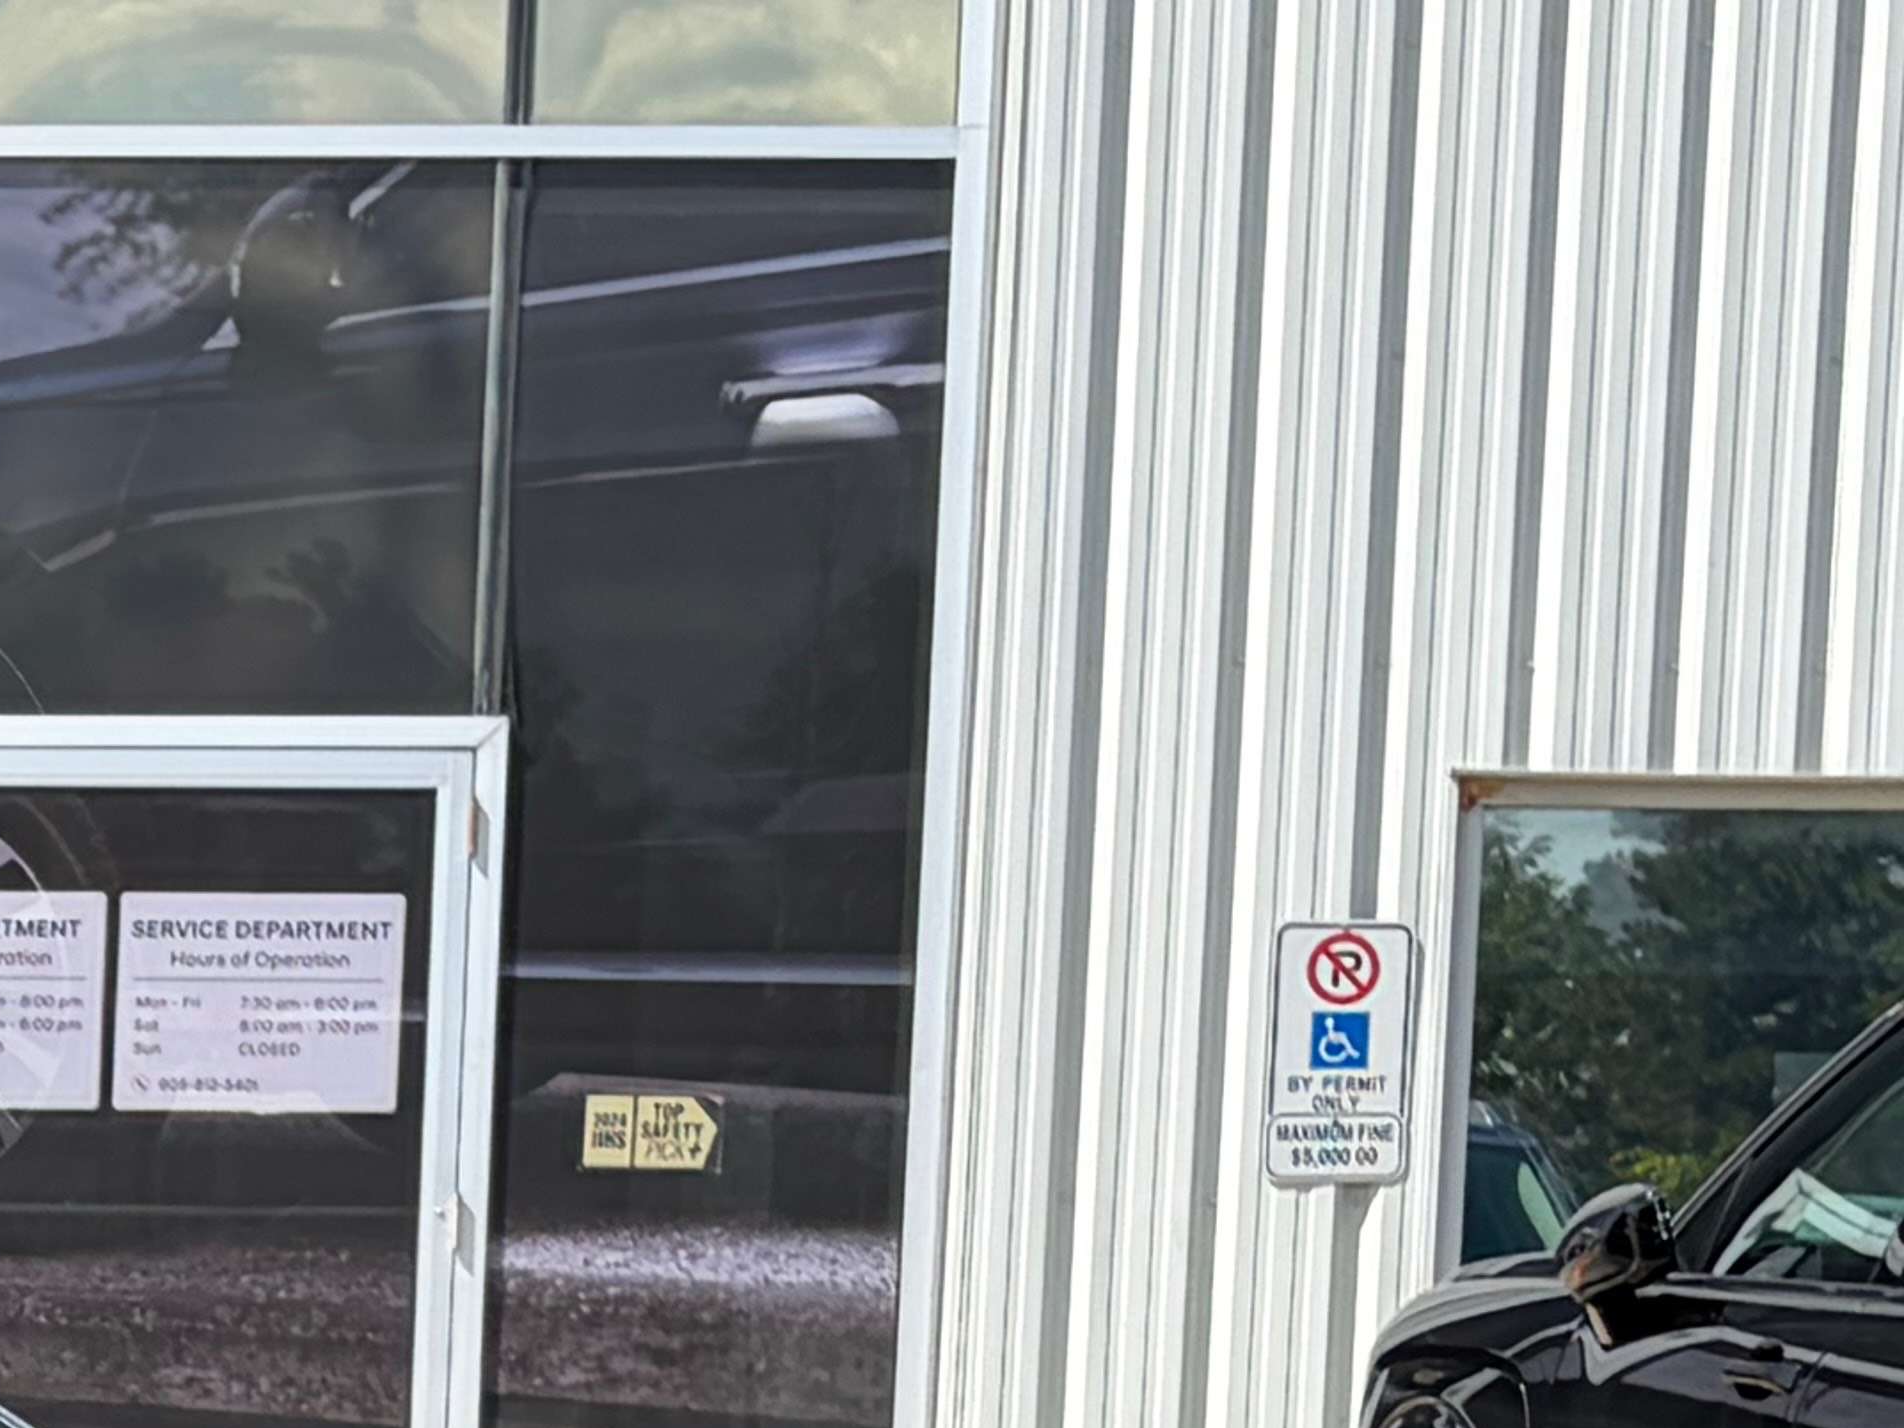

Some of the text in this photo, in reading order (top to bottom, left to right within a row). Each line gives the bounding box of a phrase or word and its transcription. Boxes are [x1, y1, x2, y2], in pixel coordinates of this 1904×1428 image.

[130, 919, 394, 941] SERVICE DEPARTMENT
[170, 951, 350, 970] Hours of Operation
[238, 1042, 301, 1057] CLOSED
[1287, 1075, 1387, 1093] BY PERMIT
[653, 1102, 685, 1121] TOP
[1311, 1096, 1360, 1113] ONLY
[641, 1120, 704, 1139] SAFETY
[1276, 1123, 1394, 1142] MAXIMUM FINE
